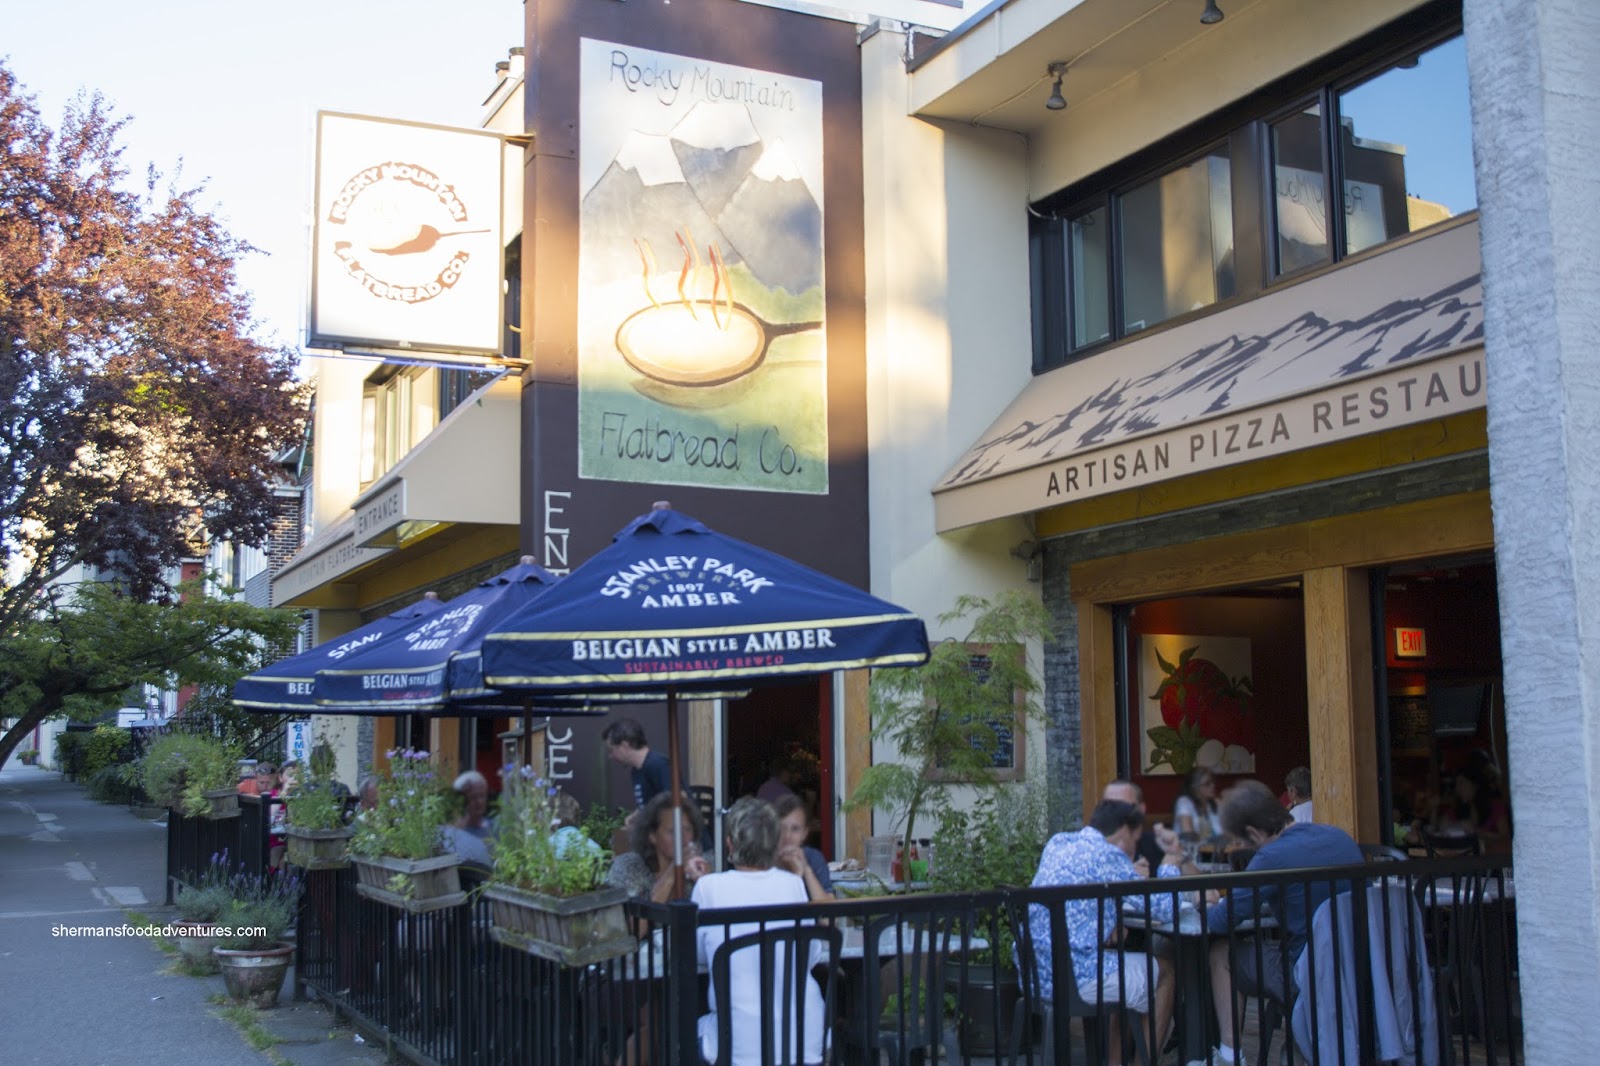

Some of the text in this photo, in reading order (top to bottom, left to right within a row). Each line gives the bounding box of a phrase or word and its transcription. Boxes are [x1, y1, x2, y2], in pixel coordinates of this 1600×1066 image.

[609, 50, 794, 111] Rocky Mountain
[329, 161, 468, 223] ROCKY MOUNTAIN
[600, 411, 803, 476] Flatbread Co.
[1046, 360, 1482, 497] ARTISAN PIZZA RESTAU
[359, 493, 398, 535] ENTRANCE
[600, 555, 775, 600] STANLEY PARK
[637, 570, 737, 591] BREWERY
[667, 583, 704, 594] 1897
[641, 591, 742, 609] AMBER
[572, 628, 836, 661] BELGIAN STYLE AMBER
[1401, 630, 1423, 651] EXIT
[625, 654, 784, 674] SUSTAINABLY BREWED
[363, 674, 408, 690] BELGIAN
